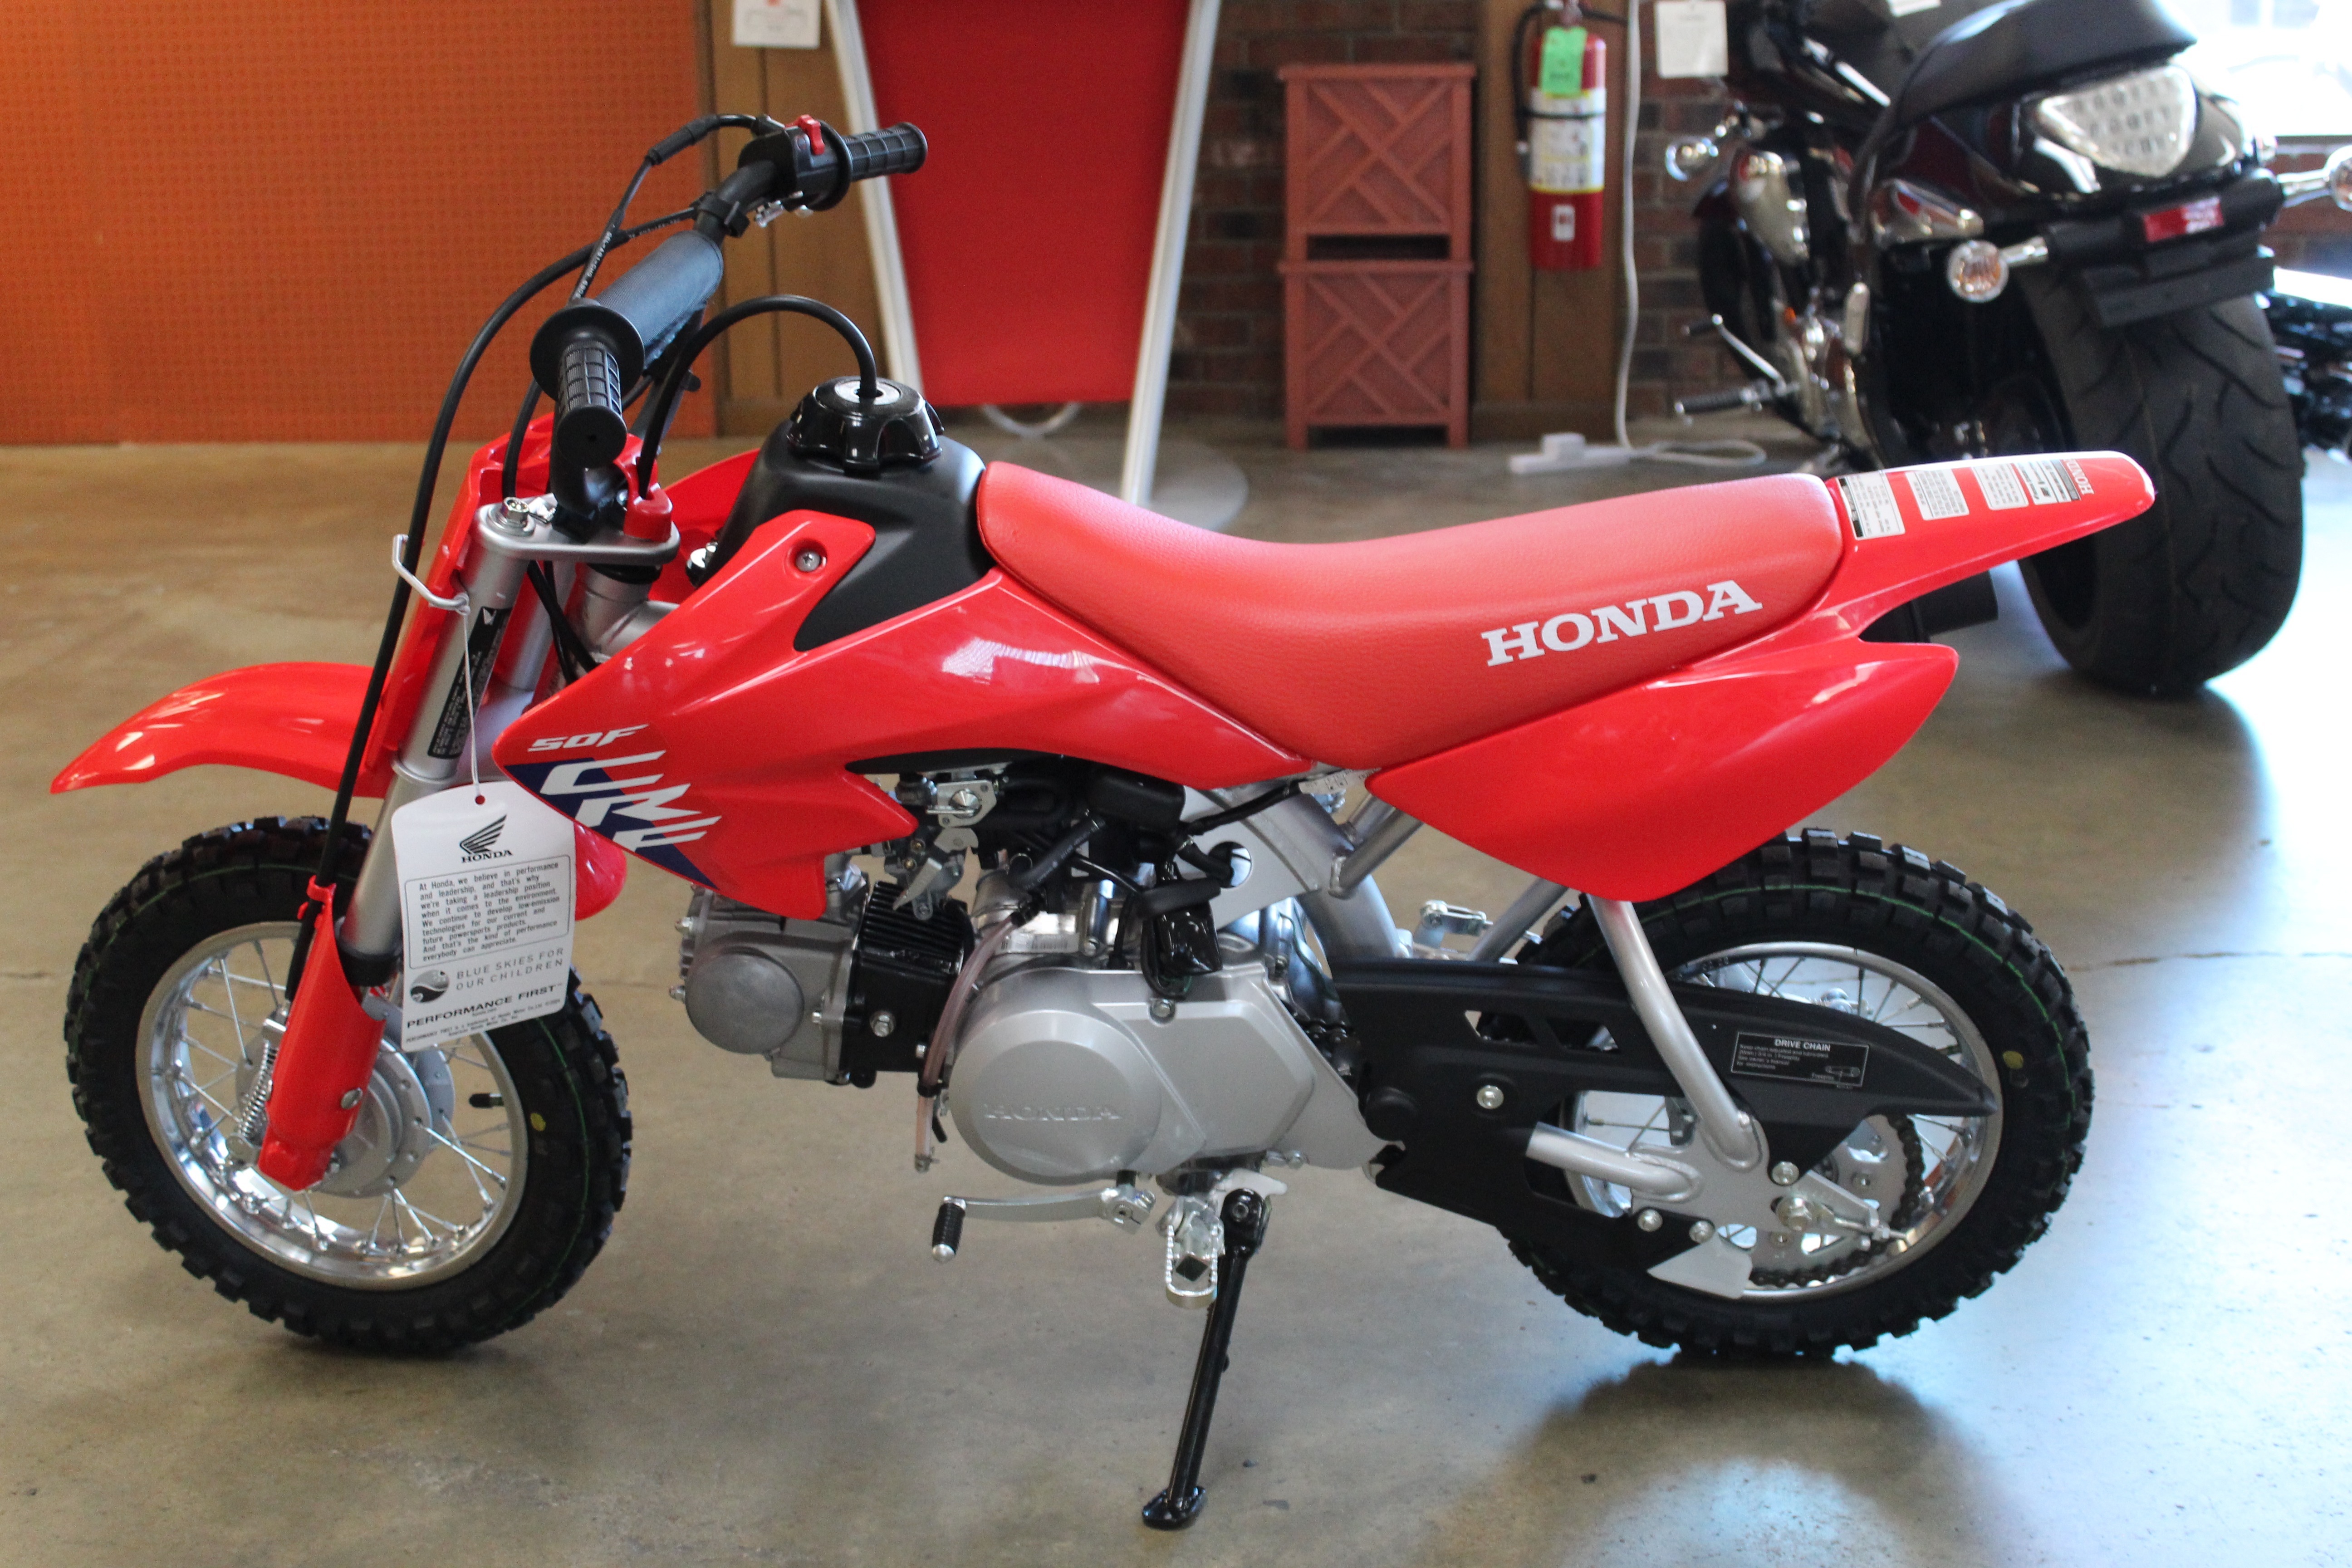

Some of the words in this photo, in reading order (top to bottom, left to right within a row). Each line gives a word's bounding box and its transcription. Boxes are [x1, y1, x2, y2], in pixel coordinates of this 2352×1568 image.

[1481, 579, 1763, 666] HONDA
[527, 724, 649, 752] 50F
[540, 750, 722, 852] CRF
[461, 849, 513, 863] HONDA
[419, 883, 426, 891] At
[474, 873, 498, 882] believe
[516, 862, 559, 877] performance
[420, 892, 432, 901] and
[501, 877, 520, 887] that's
[526, 874, 540, 883] why
[421, 901, 440, 910] we're
[446, 896, 468, 906] taking
[484, 887, 519, 899] leadership
[524, 881, 551, 892] position
[421, 911, 440, 919] when
[457, 903, 479, 913] comes
[499, 897, 509, 905] the
[422, 923, 466, 936] technologies
[504, 911, 528, 921] current
[439, 914, 468, 925] continue
[487, 905, 513, 916] develop
[519, 896, 560, 909] low-emission
[422, 936, 443, 945] future
[449, 926, 491, 941] powersports
[423, 945, 436, 953] And
[442, 940, 461, 950] that's
[516, 920, 558, 935] performance
[423, 949, 457, 962] everybody
[456, 964, 490, 980] BLUE
[495, 955, 534, 971] SKIES
[539, 947, 564, 962] FOR
[456, 977, 484, 991] OUR
[490, 958, 564, 984] CHILDREN
[407, 995, 512, 1029] PERFORMANCE
[1774, 1039, 1801, 1049] DRIVE
[1803, 1042, 1830, 1052] CHAIN
[984, 1103, 1123, 1121] HONDA
